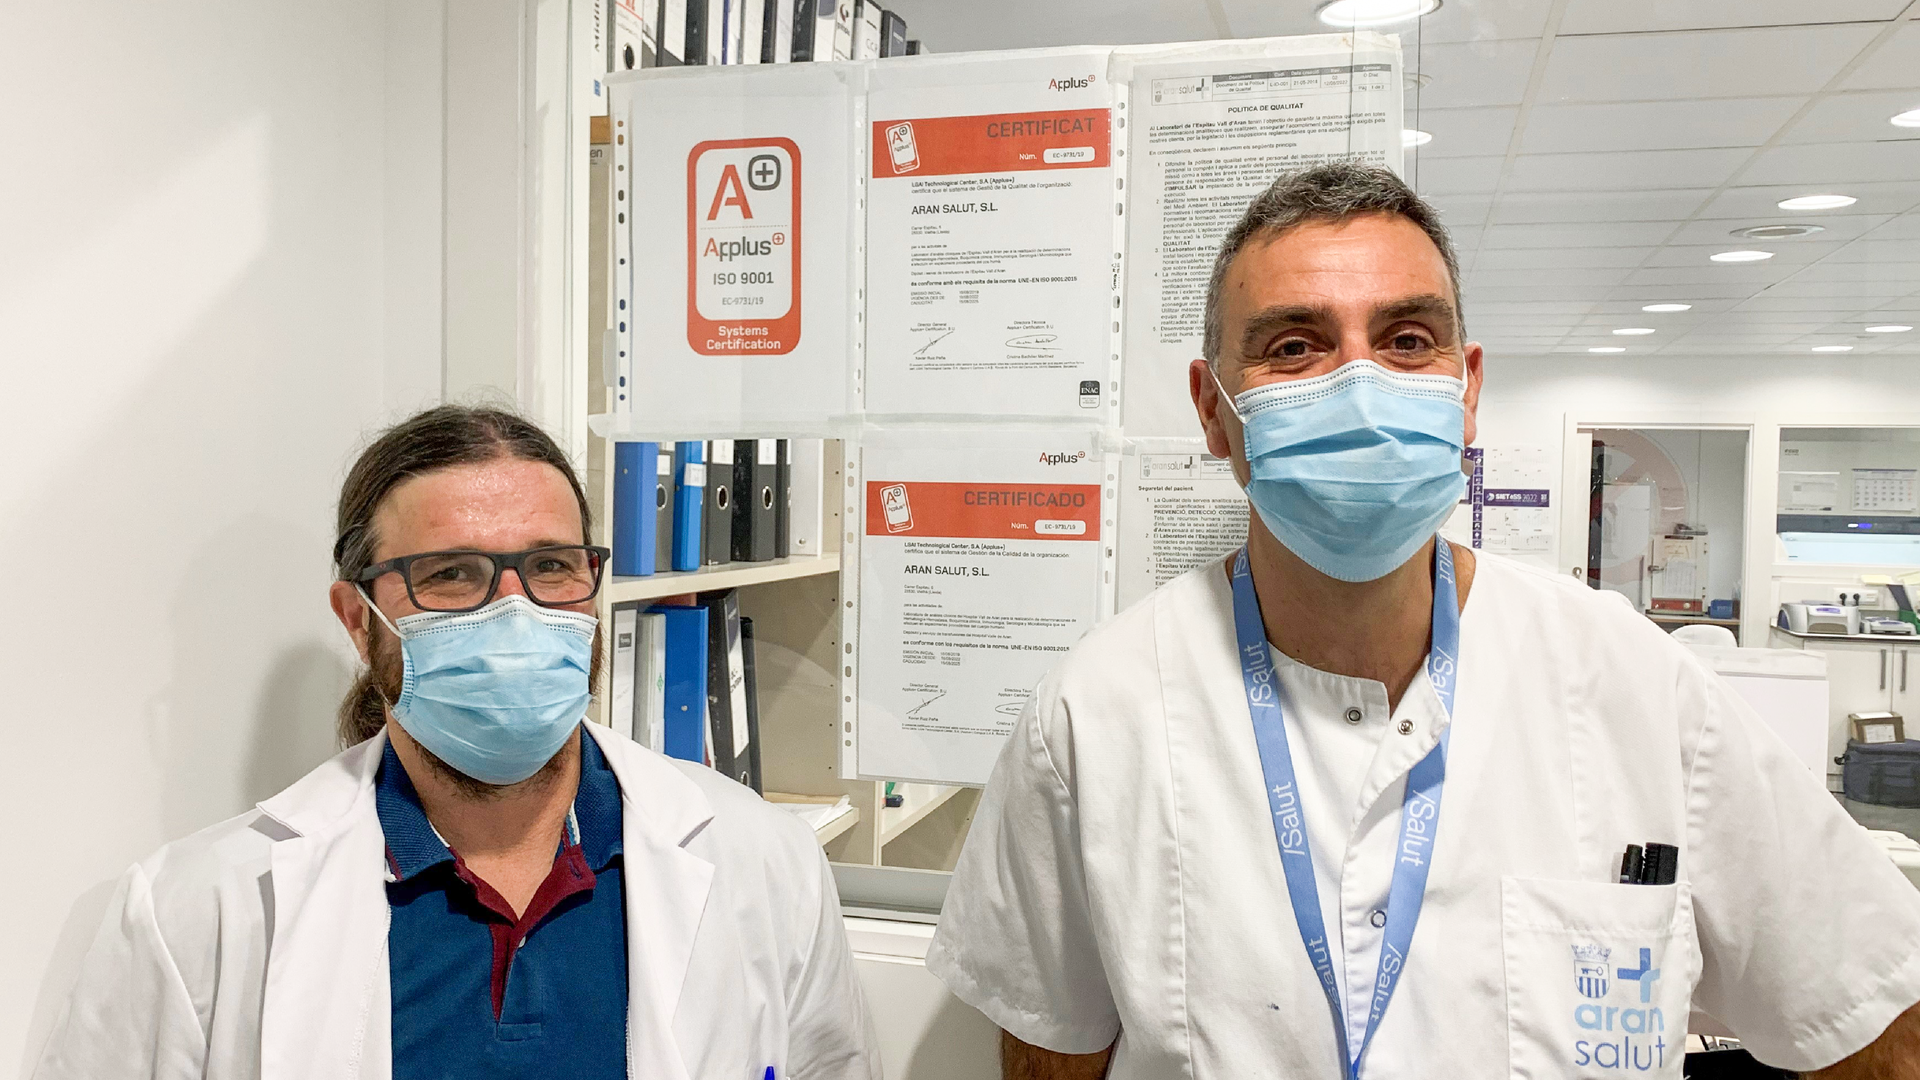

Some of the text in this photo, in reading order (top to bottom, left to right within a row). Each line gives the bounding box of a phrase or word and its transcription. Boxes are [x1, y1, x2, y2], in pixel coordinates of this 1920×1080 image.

[987, 118, 1095, 138] CERTIFICAT
[1019, 152, 1037, 160] Núm.
[912, 202, 998, 214] ARAN SALUT, S.L.
[714, 272, 774, 285] ISO 9001
[722, 297, 764, 306] EC-9731/19
[719, 326, 768, 338] Systems
[707, 339, 780, 350] Certification
[964, 491, 1085, 507] CERTIFICADO
[905, 565, 989, 576] ARAN SALUT, S.L.
[1273, 782, 1305, 855] /Salut
[1401, 789, 1435, 867] /Salut
[1574, 1004, 1665, 1034] aran
[1576, 1036, 1665, 1071] salut
